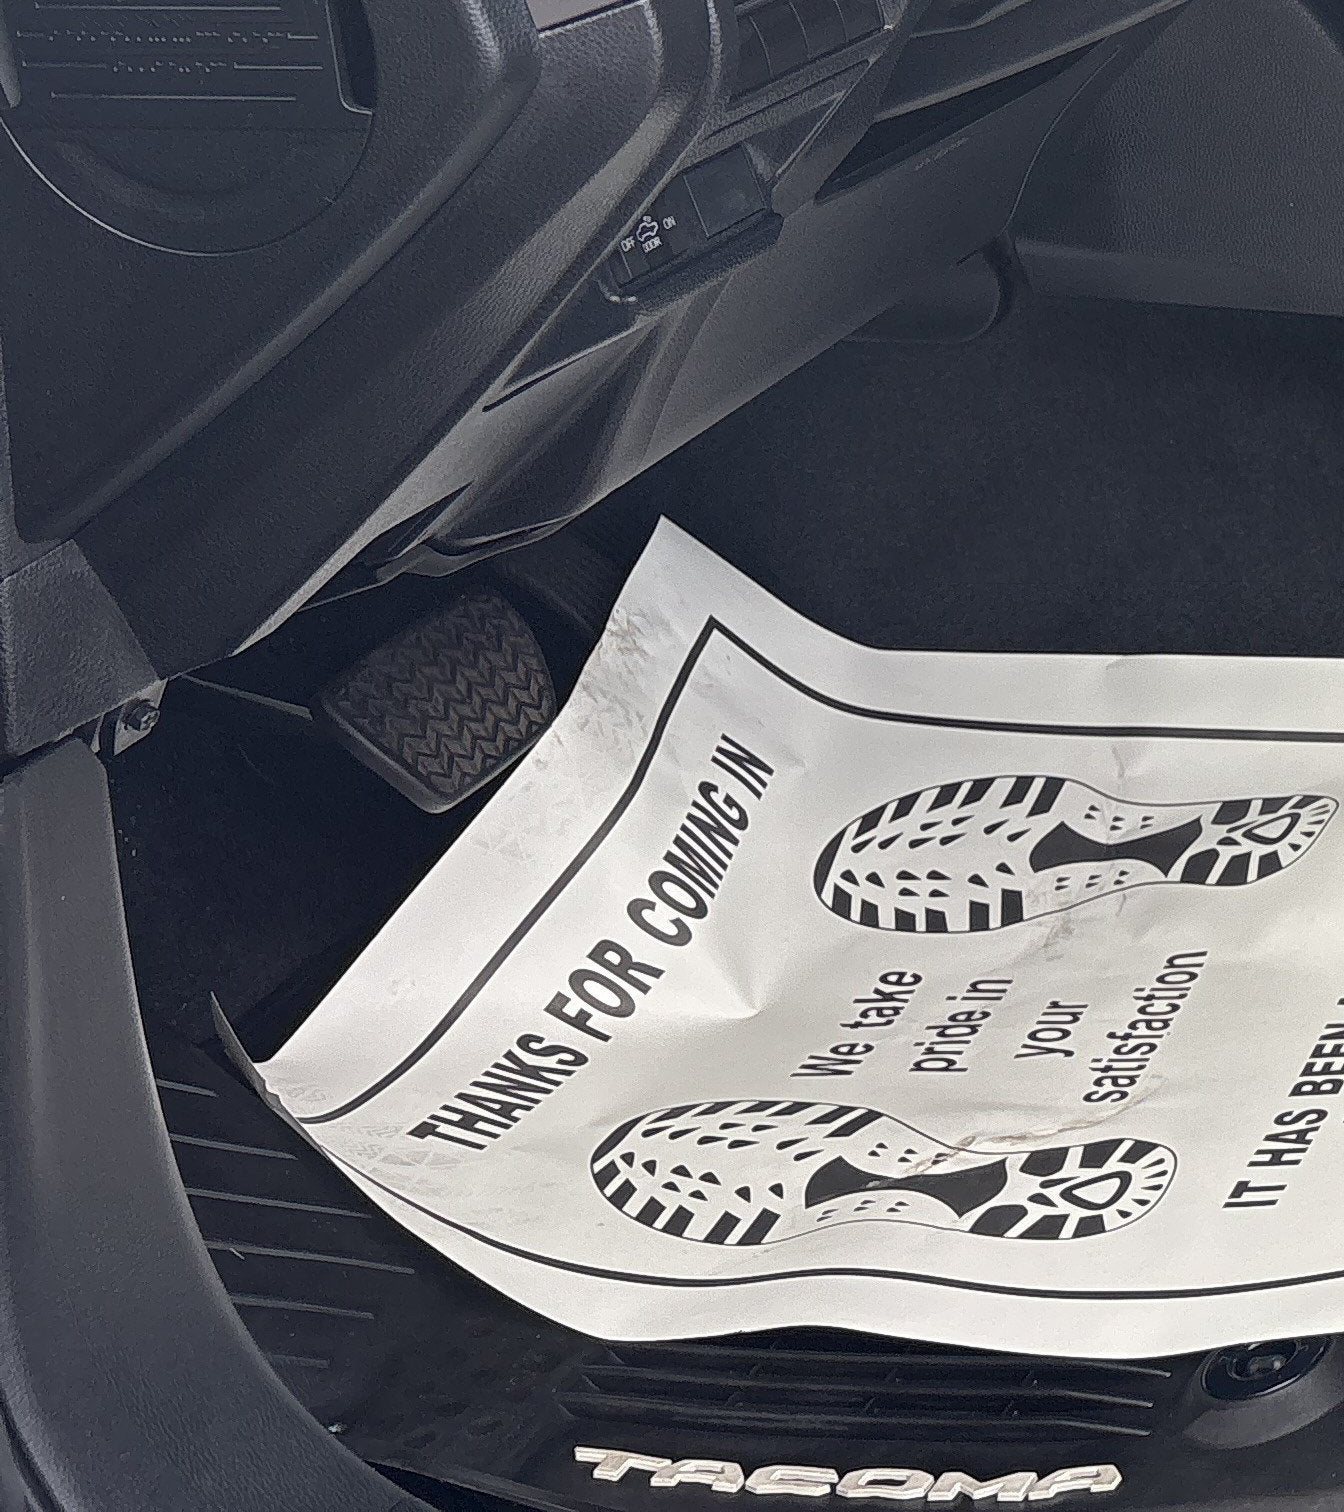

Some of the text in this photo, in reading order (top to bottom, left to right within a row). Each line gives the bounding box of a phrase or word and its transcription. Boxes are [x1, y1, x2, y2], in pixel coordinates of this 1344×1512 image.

[620, 236, 636, 253] OFF
[406, 733, 774, 1150] THANKS FOR COMING IN
[790, 972, 922, 1077] We take
[909, 980, 1013, 1072] pride in
[1014, 1001, 1089, 1059] your
[1083, 951, 1207, 1102] satisfaction
[1247, 1109, 1328, 1167] HAS
[1222, 1180, 1287, 1208] IT
[574, 1446, 1123, 1502] TACOMA
